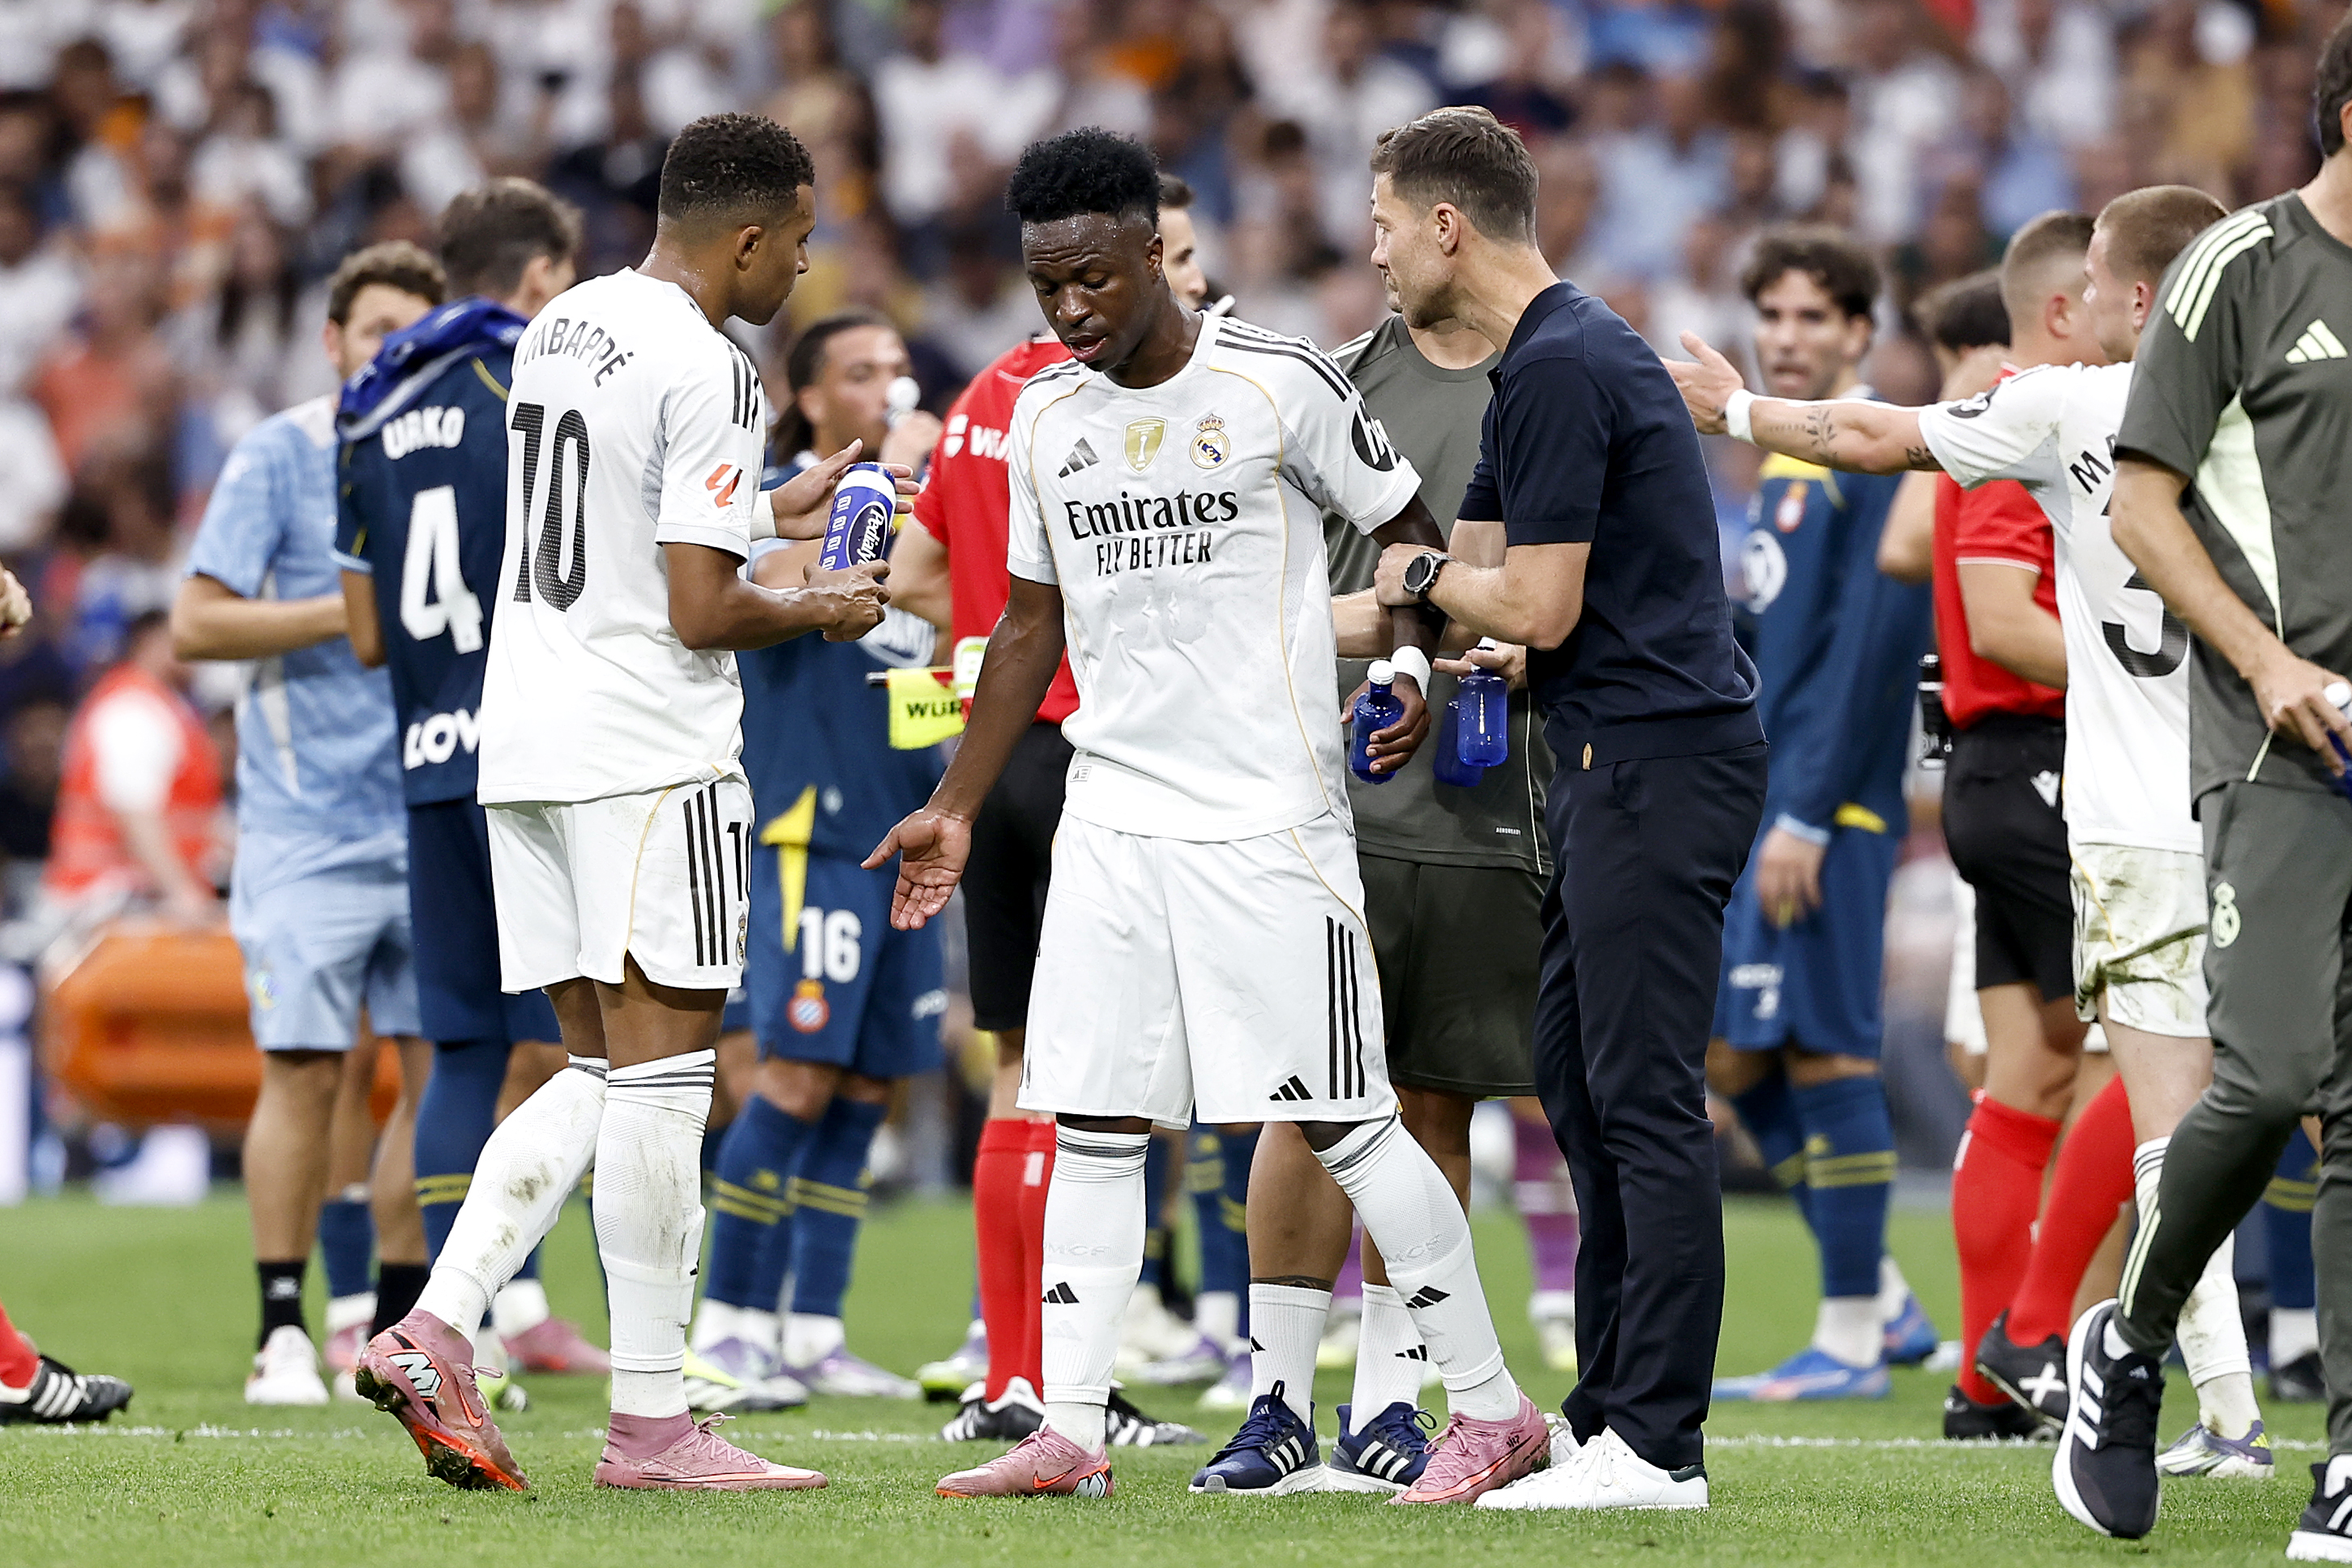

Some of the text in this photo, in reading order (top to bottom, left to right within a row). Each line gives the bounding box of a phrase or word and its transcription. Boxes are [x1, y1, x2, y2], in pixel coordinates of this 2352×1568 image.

[524, 318, 634, 387] MBAPPÉ
[511, 402, 590, 613] 10
[1064, 489, 1238, 540] Emirates
[400, 485, 484, 655] 4
[1097, 532, 1212, 576] FLY BETTER
[798, 906, 862, 983] 16
